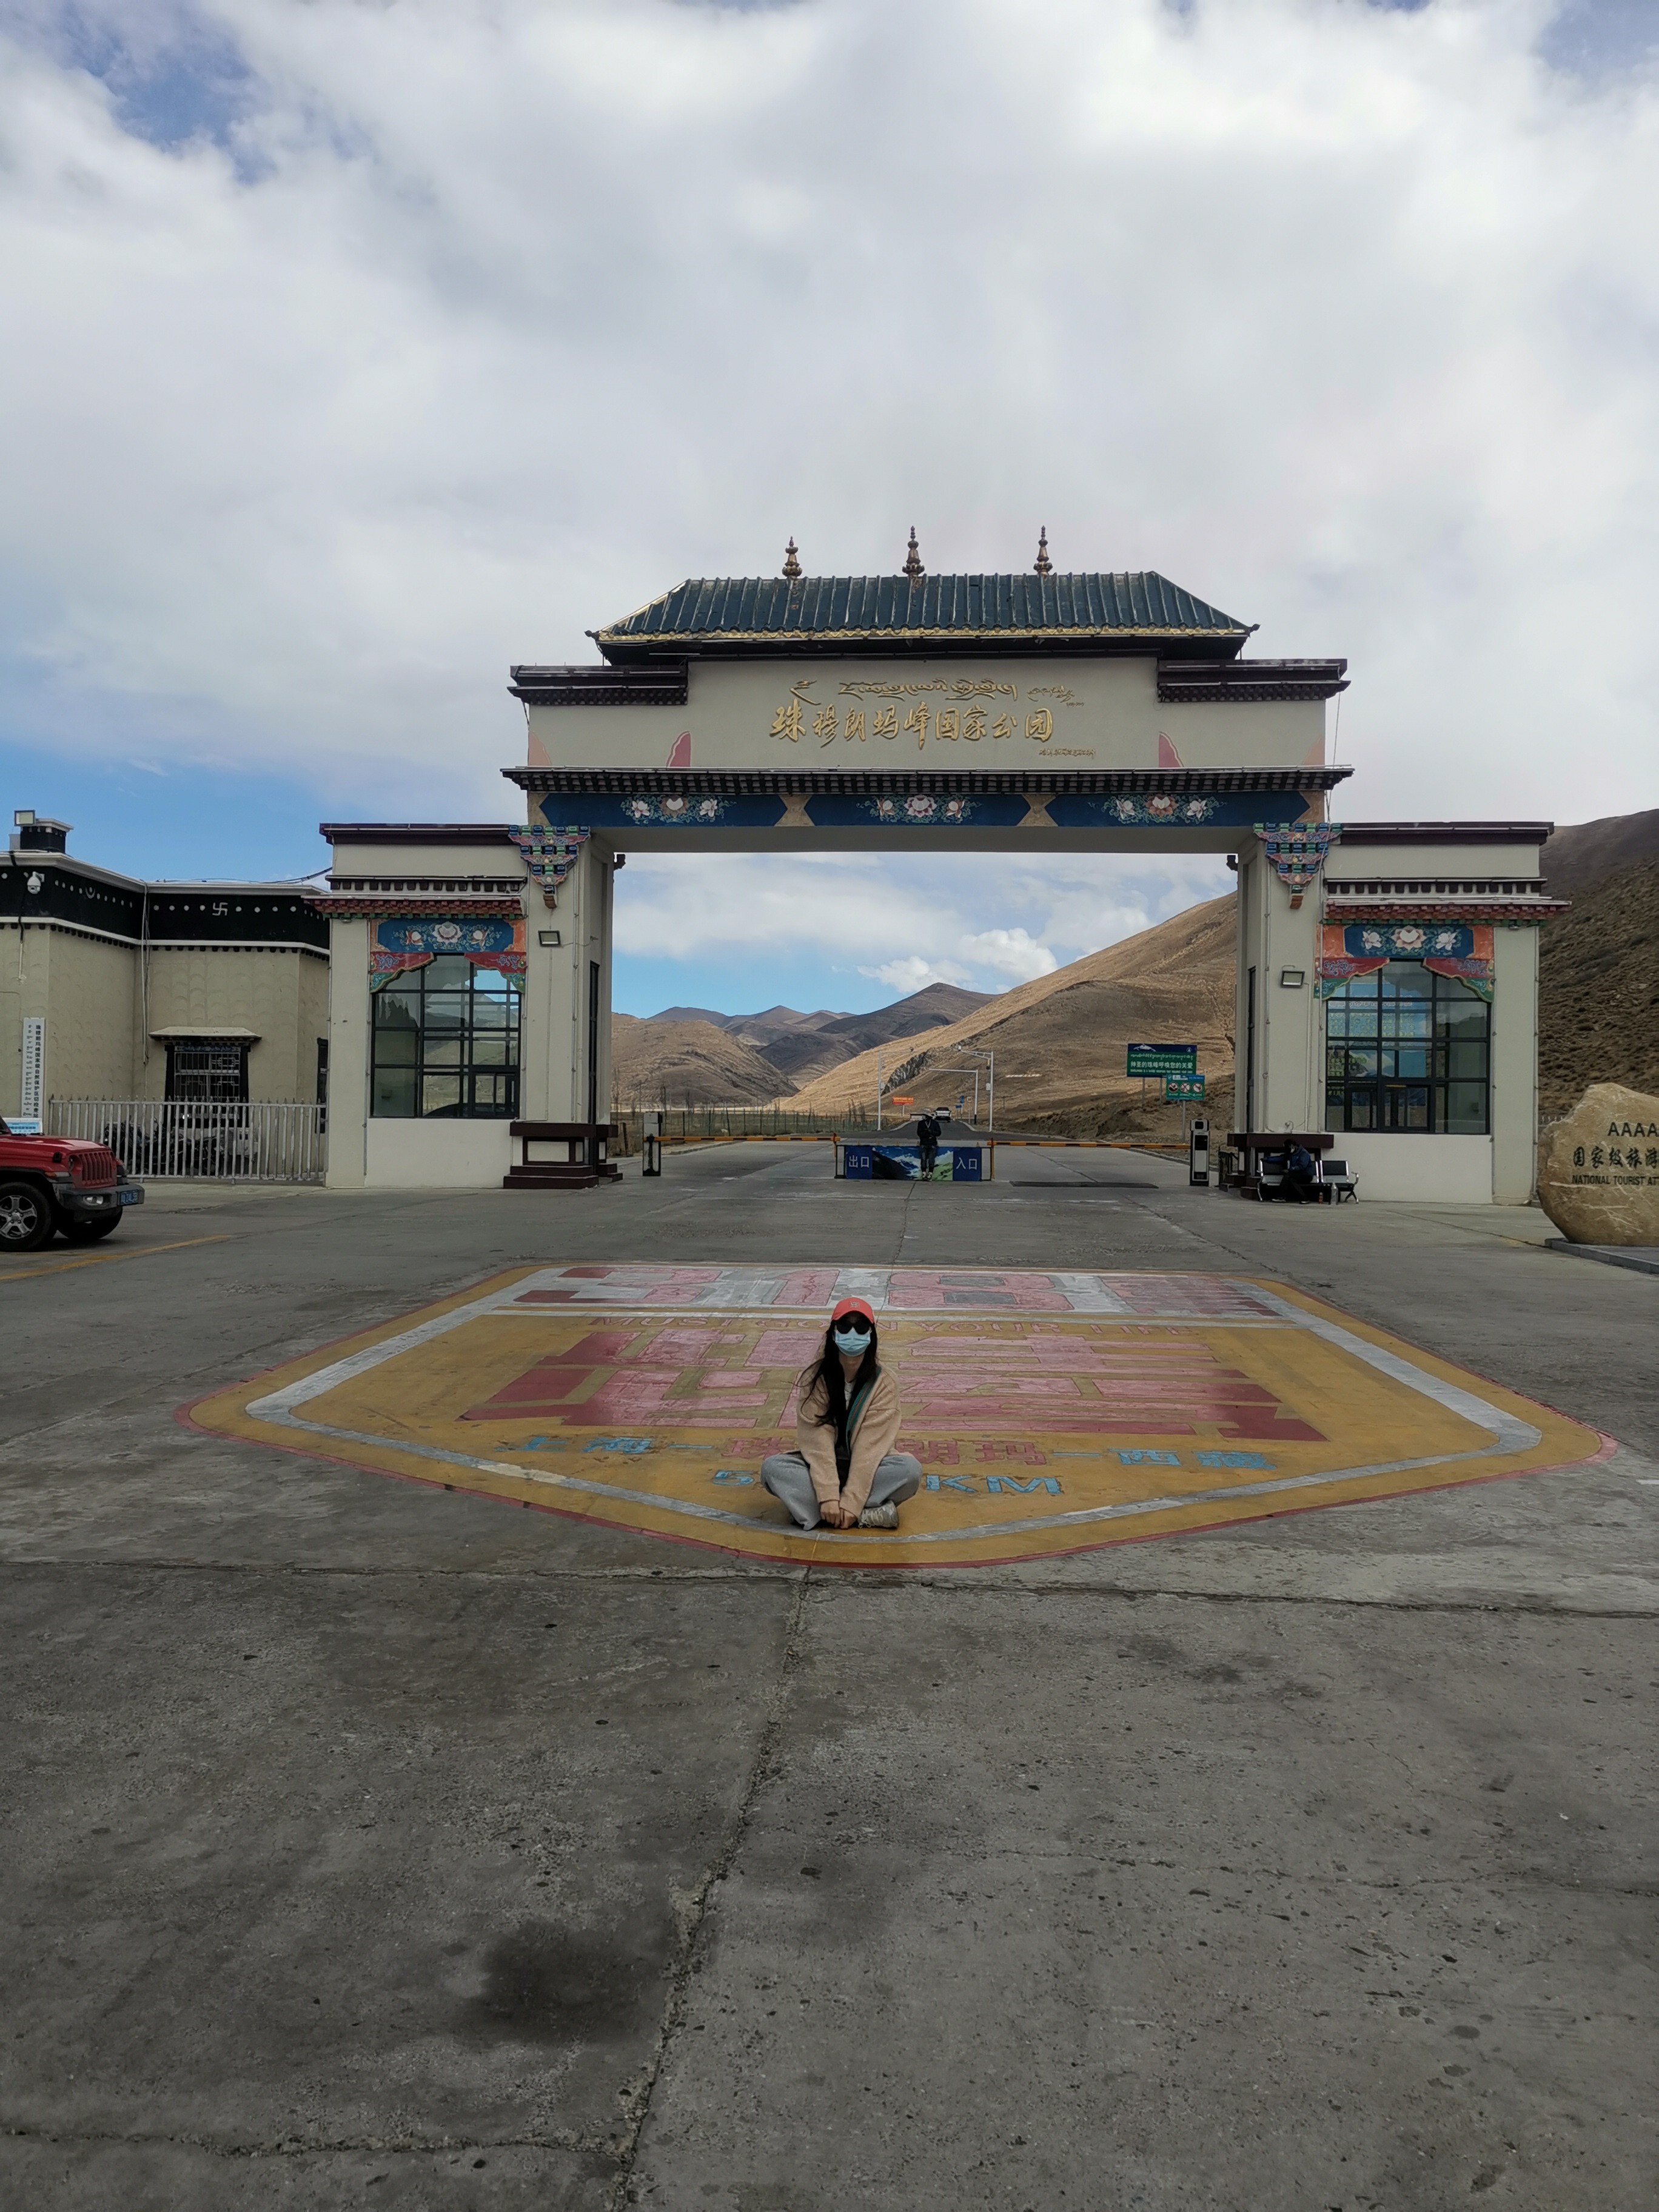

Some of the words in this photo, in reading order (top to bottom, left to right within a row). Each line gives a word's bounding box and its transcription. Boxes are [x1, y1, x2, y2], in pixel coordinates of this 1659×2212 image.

[768, 699, 1054, 749] 珠穆朗玛峰国家公园
[849, 1156, 870, 1168] 出口
[956, 1158, 977, 1170] 入口
[1572, 1175, 1610, 1185] NATIONAL
[1613, 1175, 1645, 1185] TOURIST
[514, 1267, 1074, 1312] 318
[756, 1319, 830, 1329] GO
[915, 1322, 1062, 1333] YOUR
[1089, 1324, 1195, 1335] LIFE
